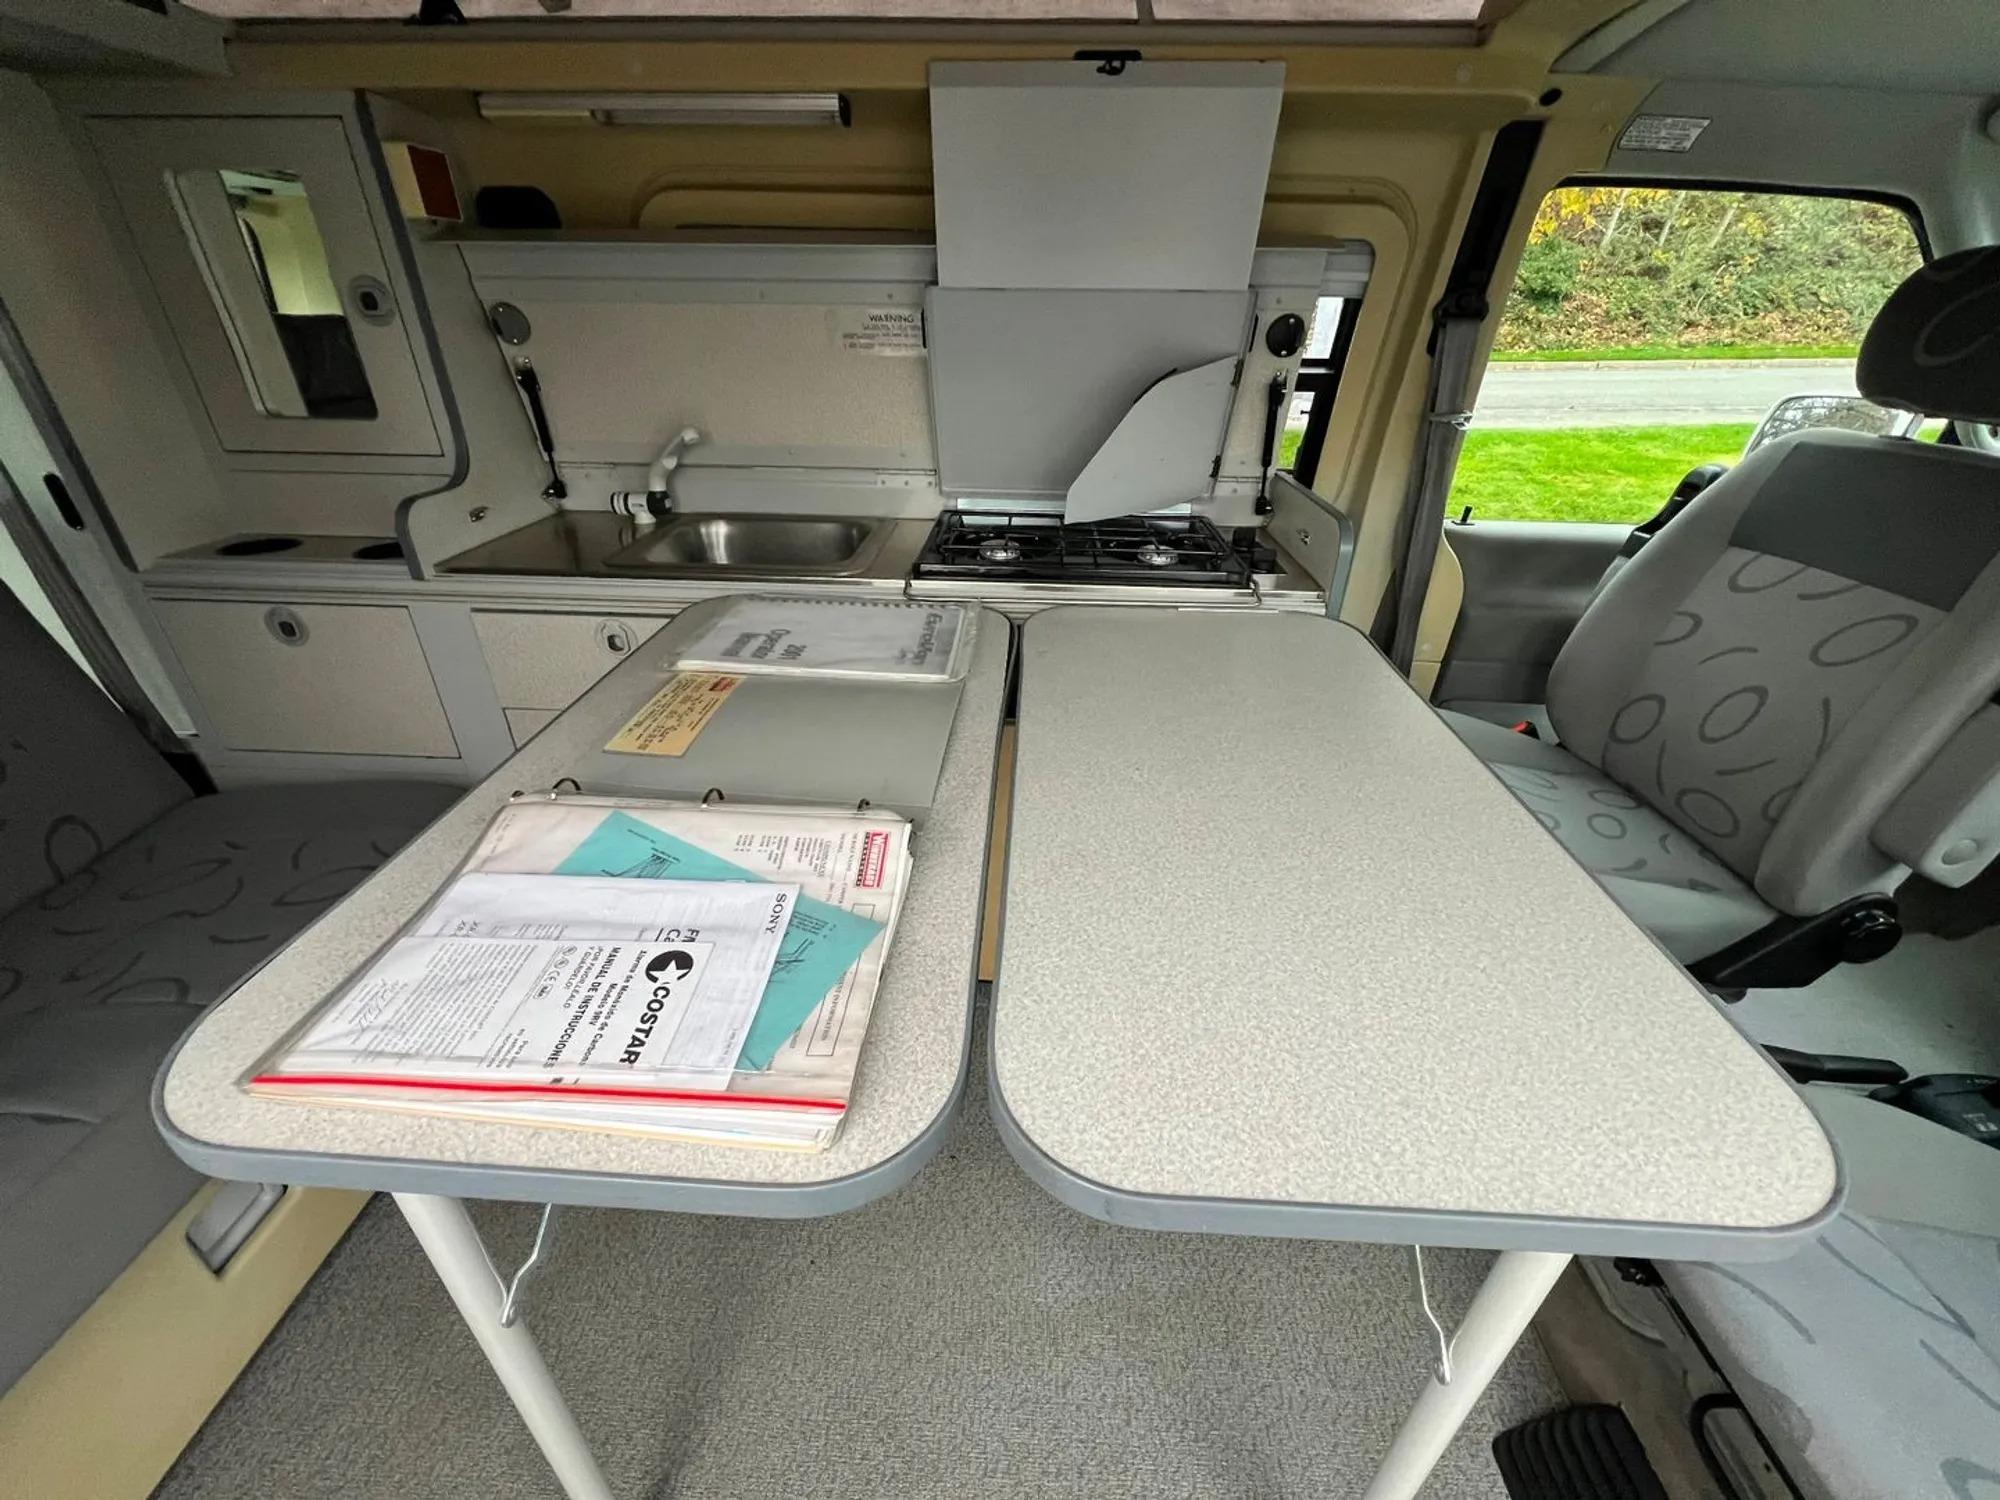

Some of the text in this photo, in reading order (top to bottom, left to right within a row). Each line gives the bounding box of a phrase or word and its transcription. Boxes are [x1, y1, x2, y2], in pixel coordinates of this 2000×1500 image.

[868, 313, 915, 323] WARNING
[765, 893, 788, 935] SONY
[597, 946, 622, 979] MANUAL
[586, 981, 602, 993] DE
[588, 983, 618, 1026] Modelo 9RV
[542, 994, 595, 1068] INSTRUCCIONES
[619, 986, 671, 1065] COSTAR
